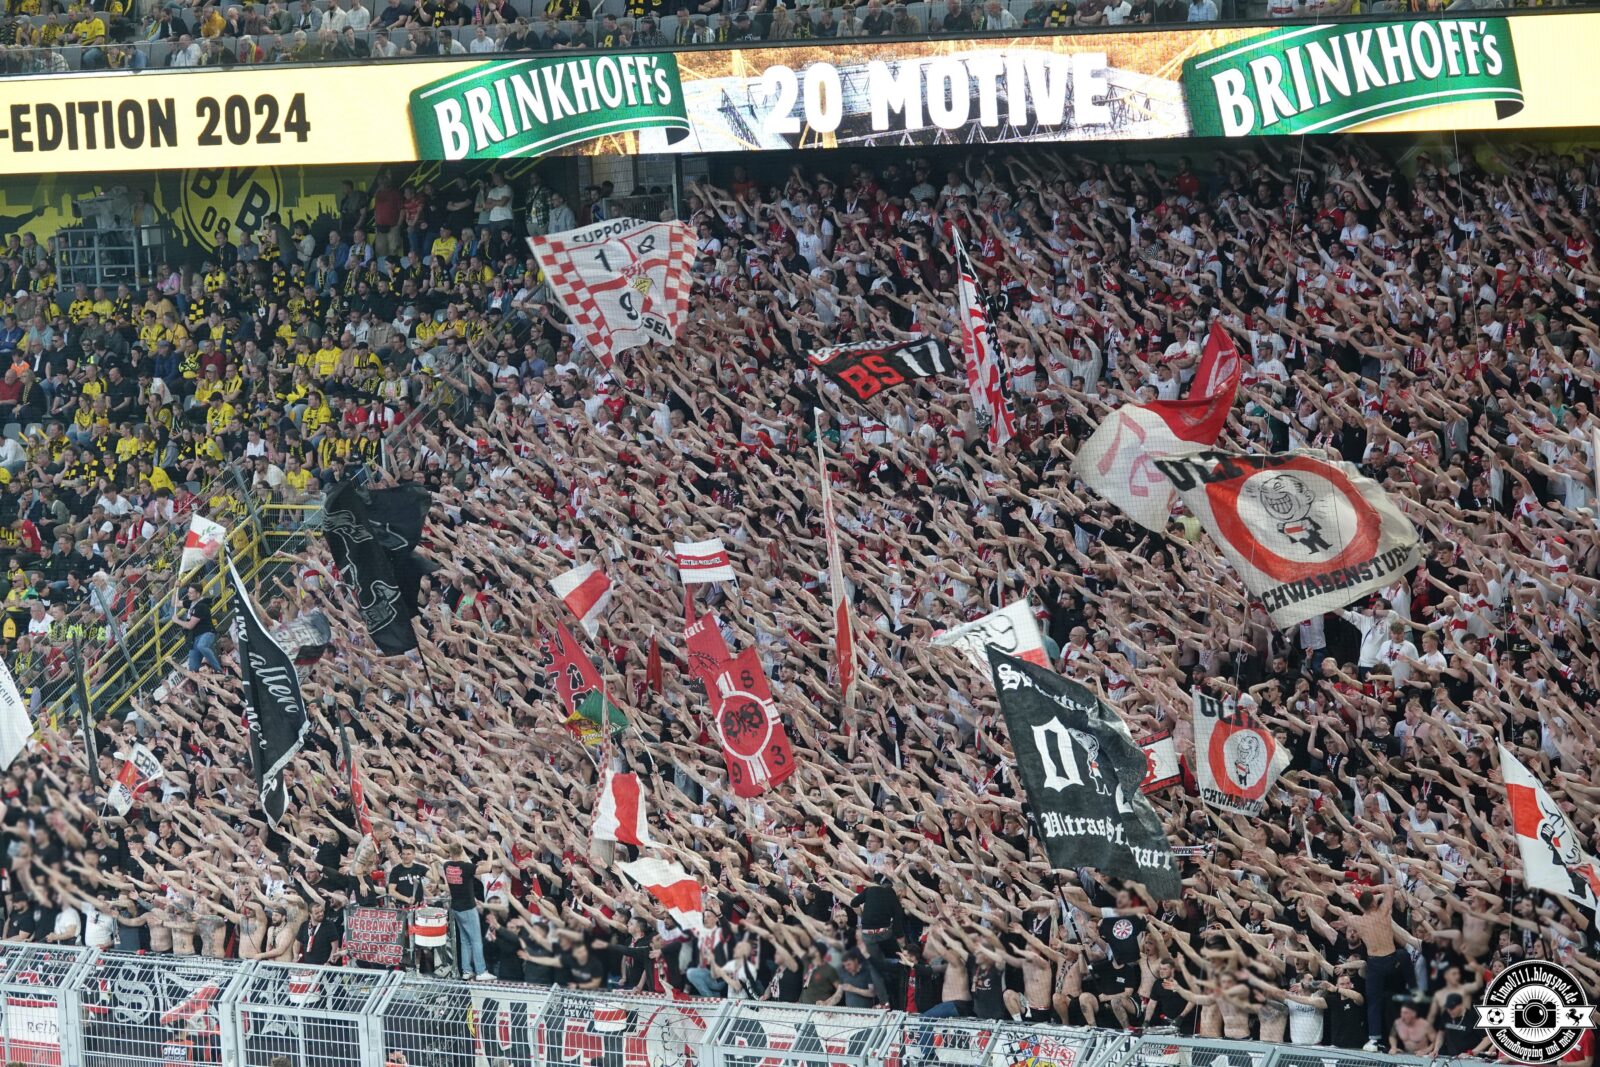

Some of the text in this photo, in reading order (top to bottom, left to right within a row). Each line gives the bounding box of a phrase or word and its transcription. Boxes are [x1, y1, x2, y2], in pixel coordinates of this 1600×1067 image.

[761, 52, 1111, 134] 20 MOTIVE
[196, 92, 311, 146] 2024
[594, 249, 613, 273] 1
[619, 291, 640, 321] 9
[838, 355, 905, 399] BS
[896, 341, 946, 377] 17
[741, 669, 755, 689] 8
[770, 744, 786, 766] 3
[347, 916, 404, 934] VERBANNTE
[354, 908, 398, 921] JEDER
